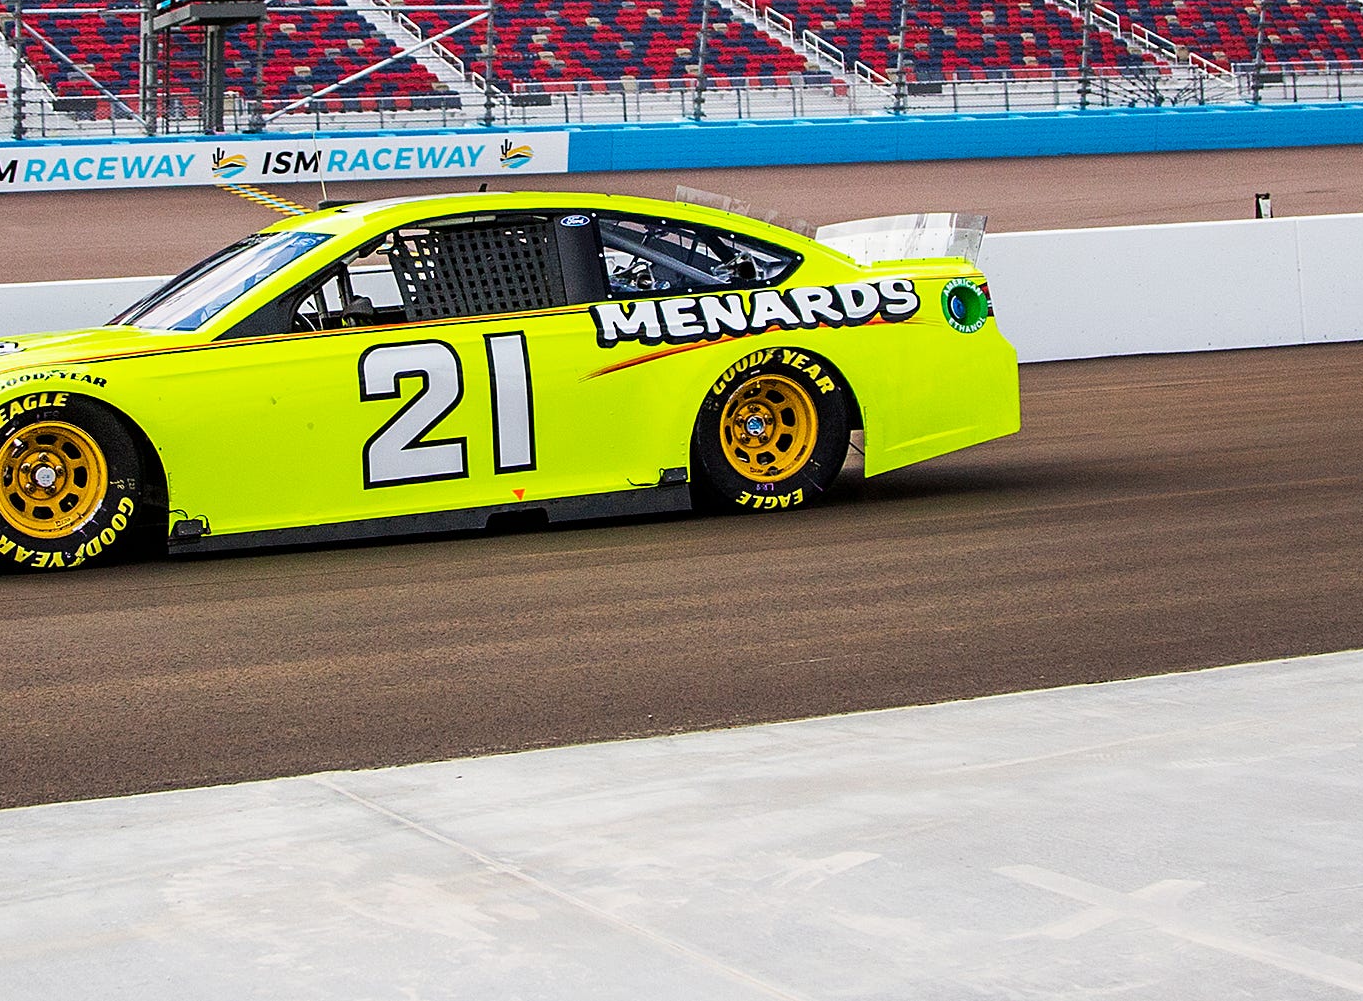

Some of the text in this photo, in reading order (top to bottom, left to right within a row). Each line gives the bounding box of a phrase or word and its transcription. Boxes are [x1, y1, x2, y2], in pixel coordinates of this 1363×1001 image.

[22, 153, 197, 184] RACEWAY
[261, 144, 486, 176] ISM RACEWAY
[943, 278, 983, 297] AMERICAN
[588, 276, 922, 349] MENARDS
[948, 316, 986, 334] ETHANOL
[357, 329, 537, 491] 21
[735, 487, 804, 510] EAGLE
